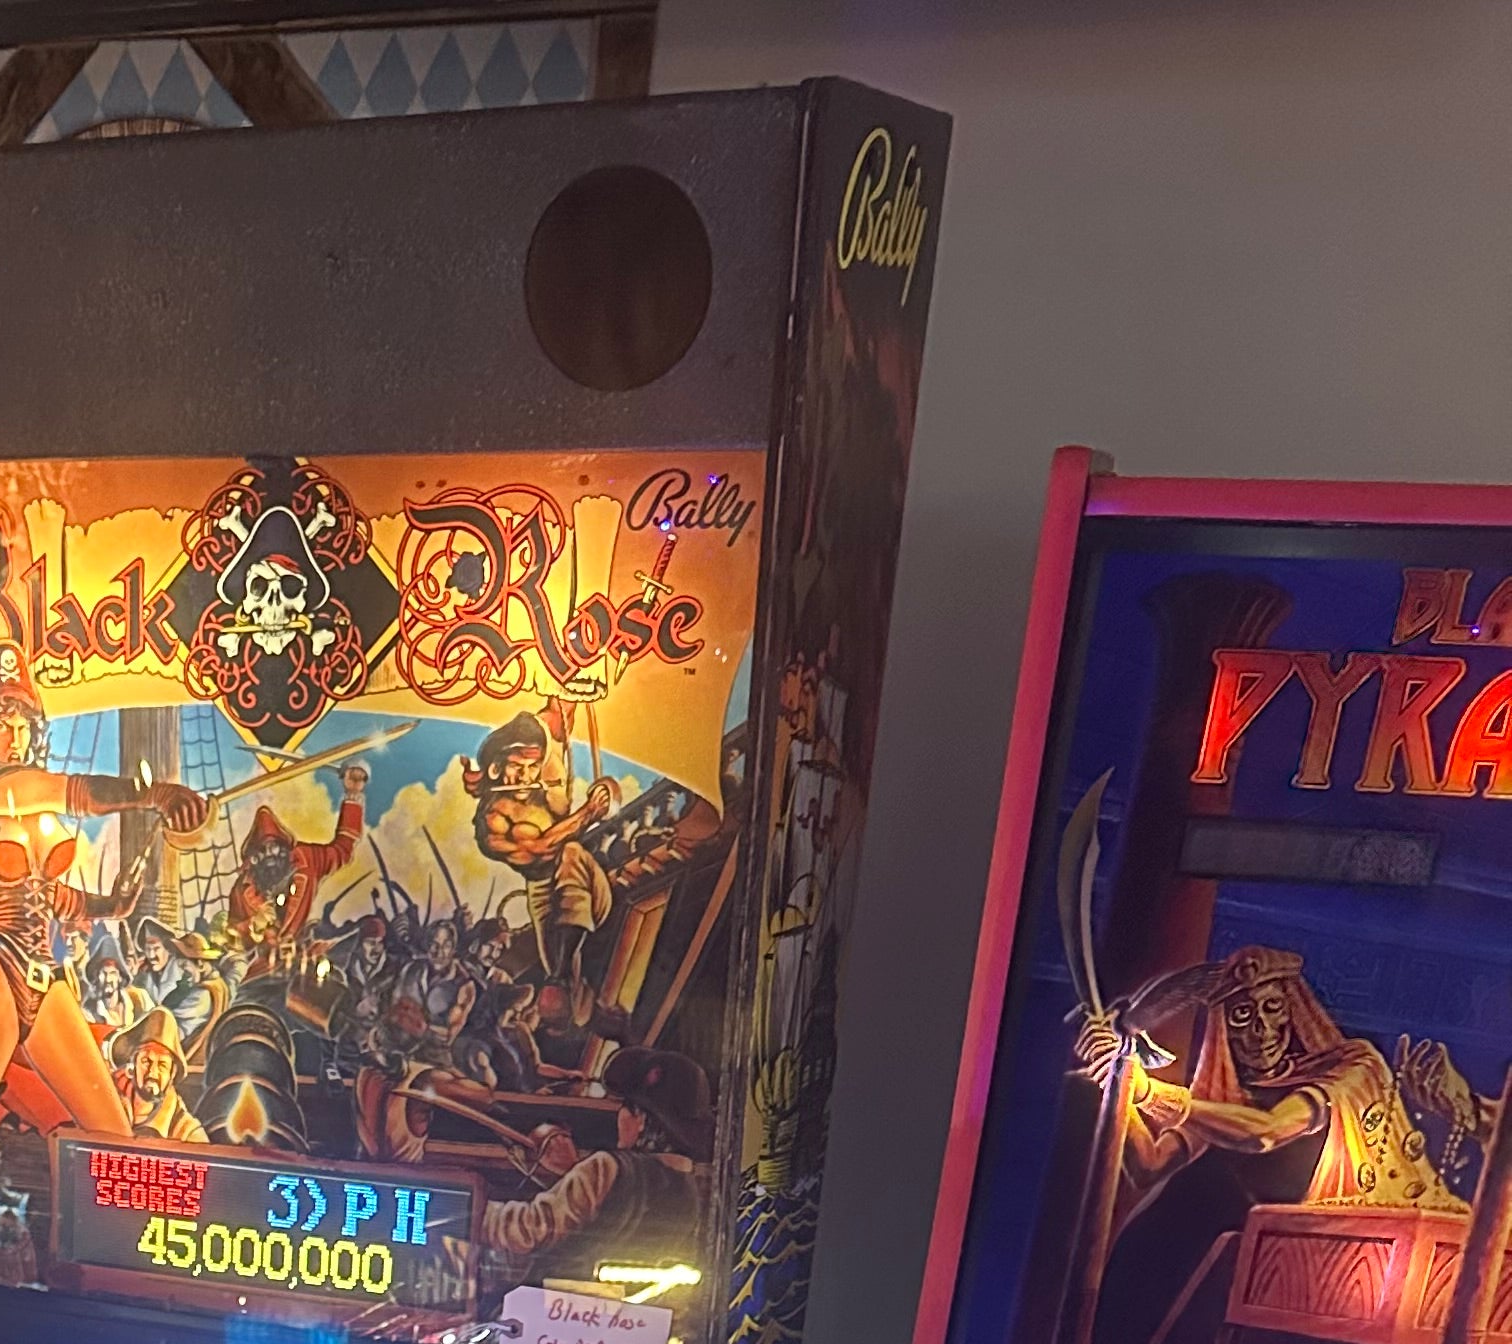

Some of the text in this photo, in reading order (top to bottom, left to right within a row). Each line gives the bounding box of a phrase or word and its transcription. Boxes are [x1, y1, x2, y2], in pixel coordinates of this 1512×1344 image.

[839, 127, 928, 307] Bally
[626, 468, 758, 549] Bally
[402, 495, 706, 692] Rose
[1190, 648, 1512, 800] PYRA
[90, 1149, 209, 1191] HIGHEST
[96, 1179, 201, 1217] SCORES
[137, 1216, 393, 1294] 45,000,000
[548, 1298, 600, 1327] Black
